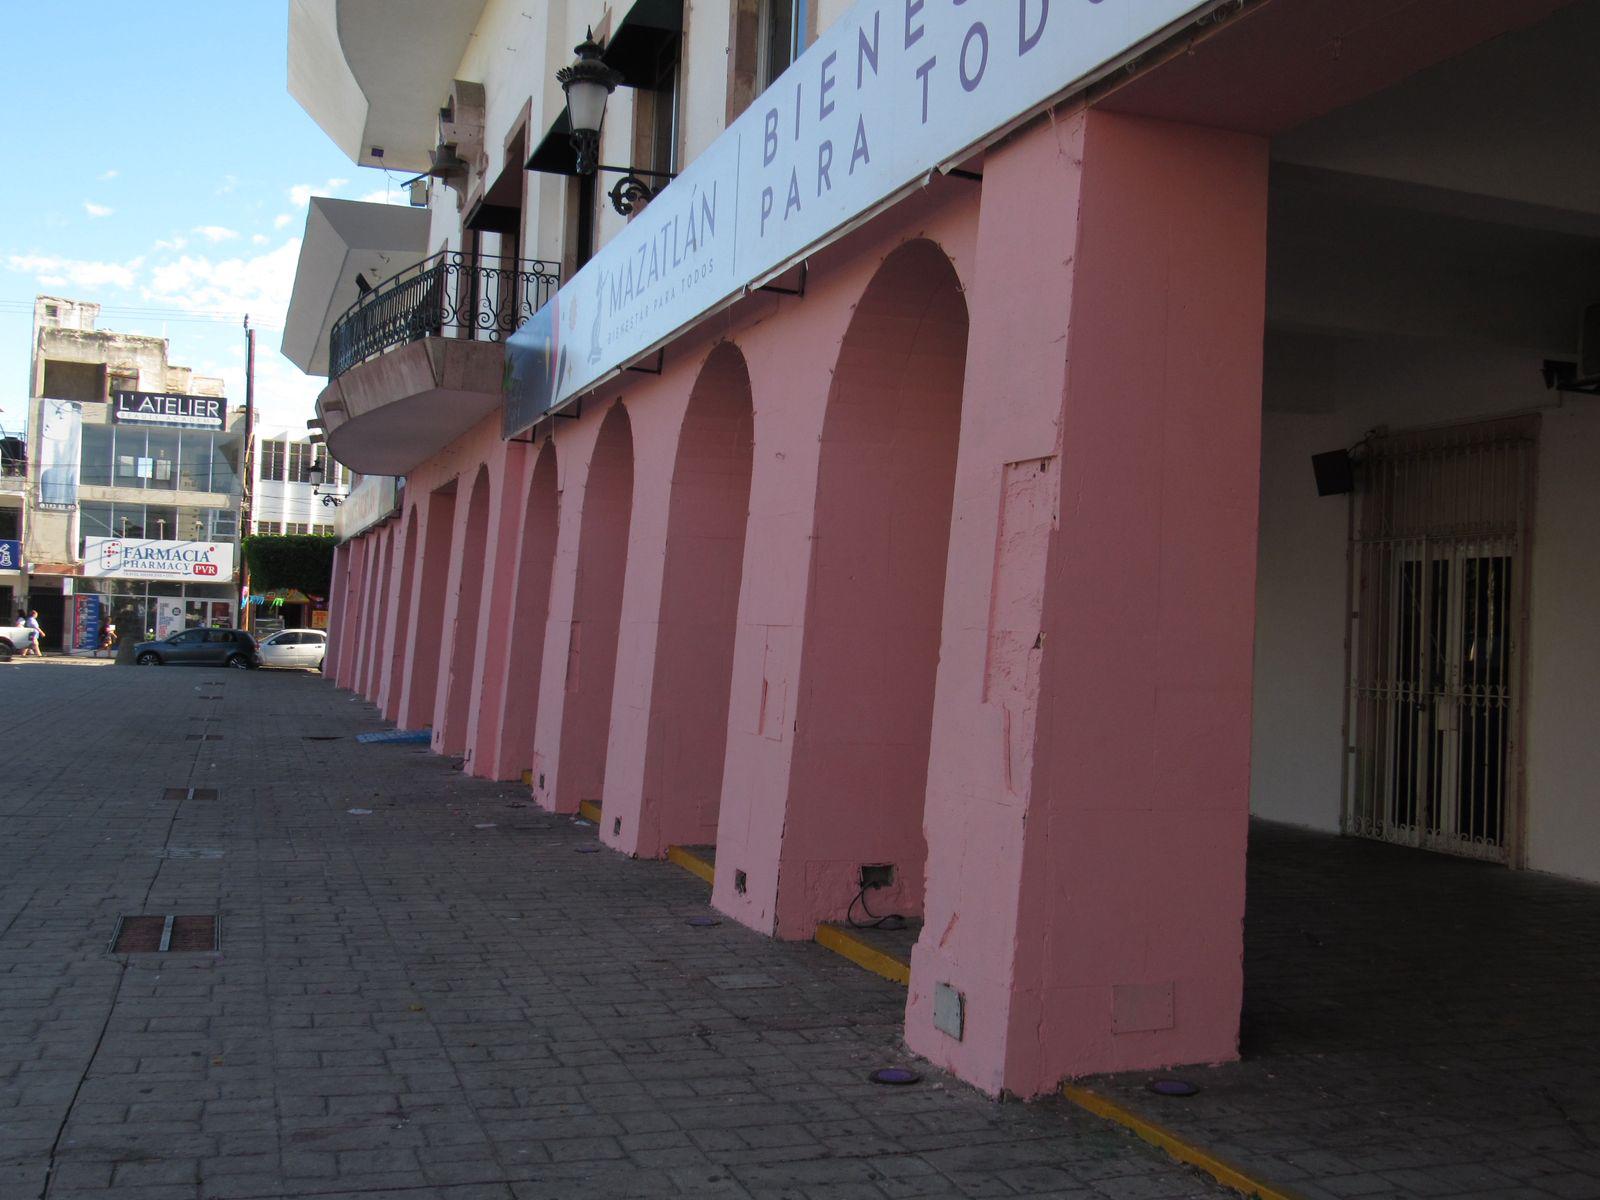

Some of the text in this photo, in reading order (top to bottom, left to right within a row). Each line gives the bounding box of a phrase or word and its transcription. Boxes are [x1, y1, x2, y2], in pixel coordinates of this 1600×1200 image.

[761, 0, 1103, 238] PARA TOD
[763, 0, 968, 168] BIENE
[609, 180, 717, 318] MAZATLÁN
[608, 258, 714, 345] BIENESTAR PARA TODOS
[167, 415, 217, 424] ACADEMY
[124, 547, 210, 562] FARMACIA
[124, 560, 216, 575] PHARMACY PVR
